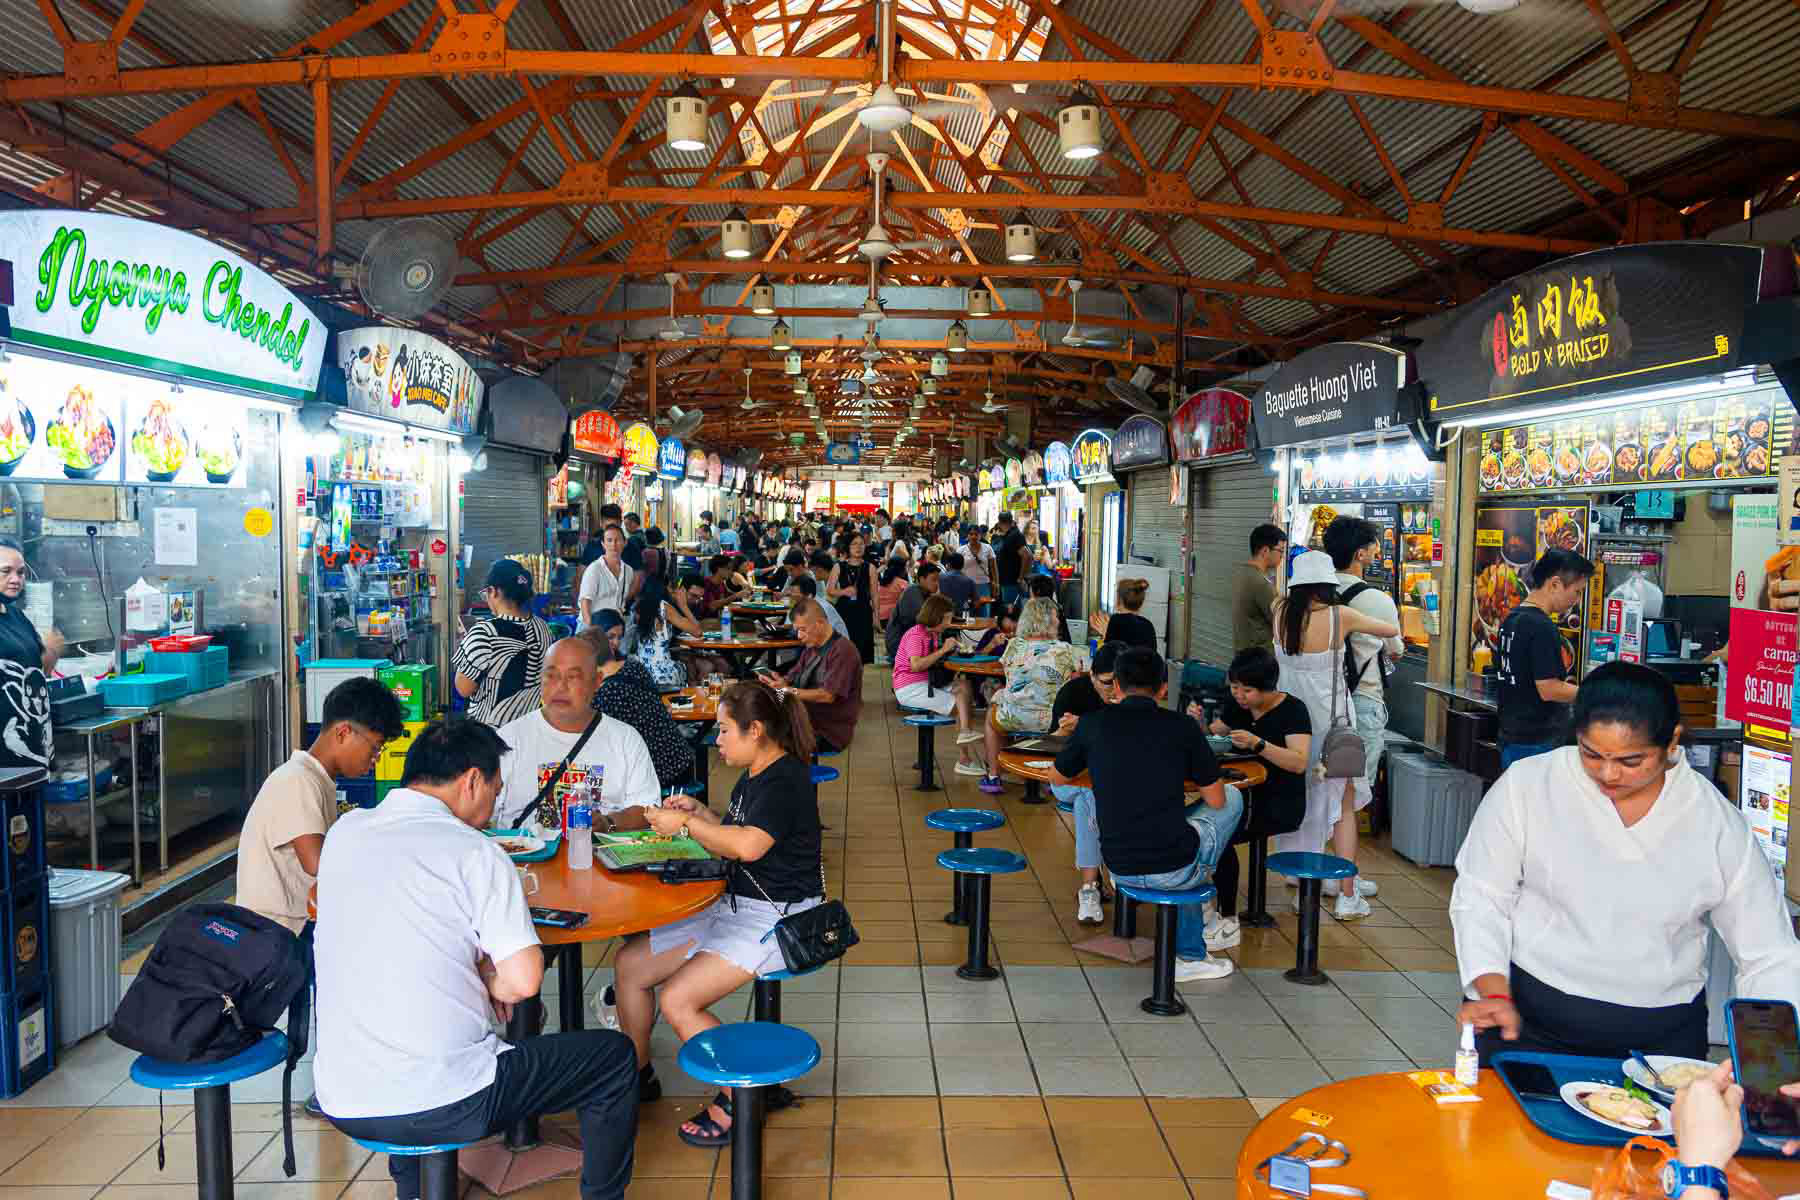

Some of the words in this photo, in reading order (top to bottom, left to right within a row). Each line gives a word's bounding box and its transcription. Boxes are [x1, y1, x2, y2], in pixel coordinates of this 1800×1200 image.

[36, 226, 190, 335] Nyonya
[203, 260, 310, 372] Chendol
[1511, 345, 1540, 376] BOLD
[1557, 333, 1609, 368] BRAISED
[1265, 382, 1308, 418] Baguette
[1310, 374, 1348, 403] Huong
[1349, 359, 1378, 392] Viet
[1294, 412, 1321, 427] Vietnamese
[1322, 408, 1343, 422] Cuisine
[1744, 673, 1773, 706] $6.50
